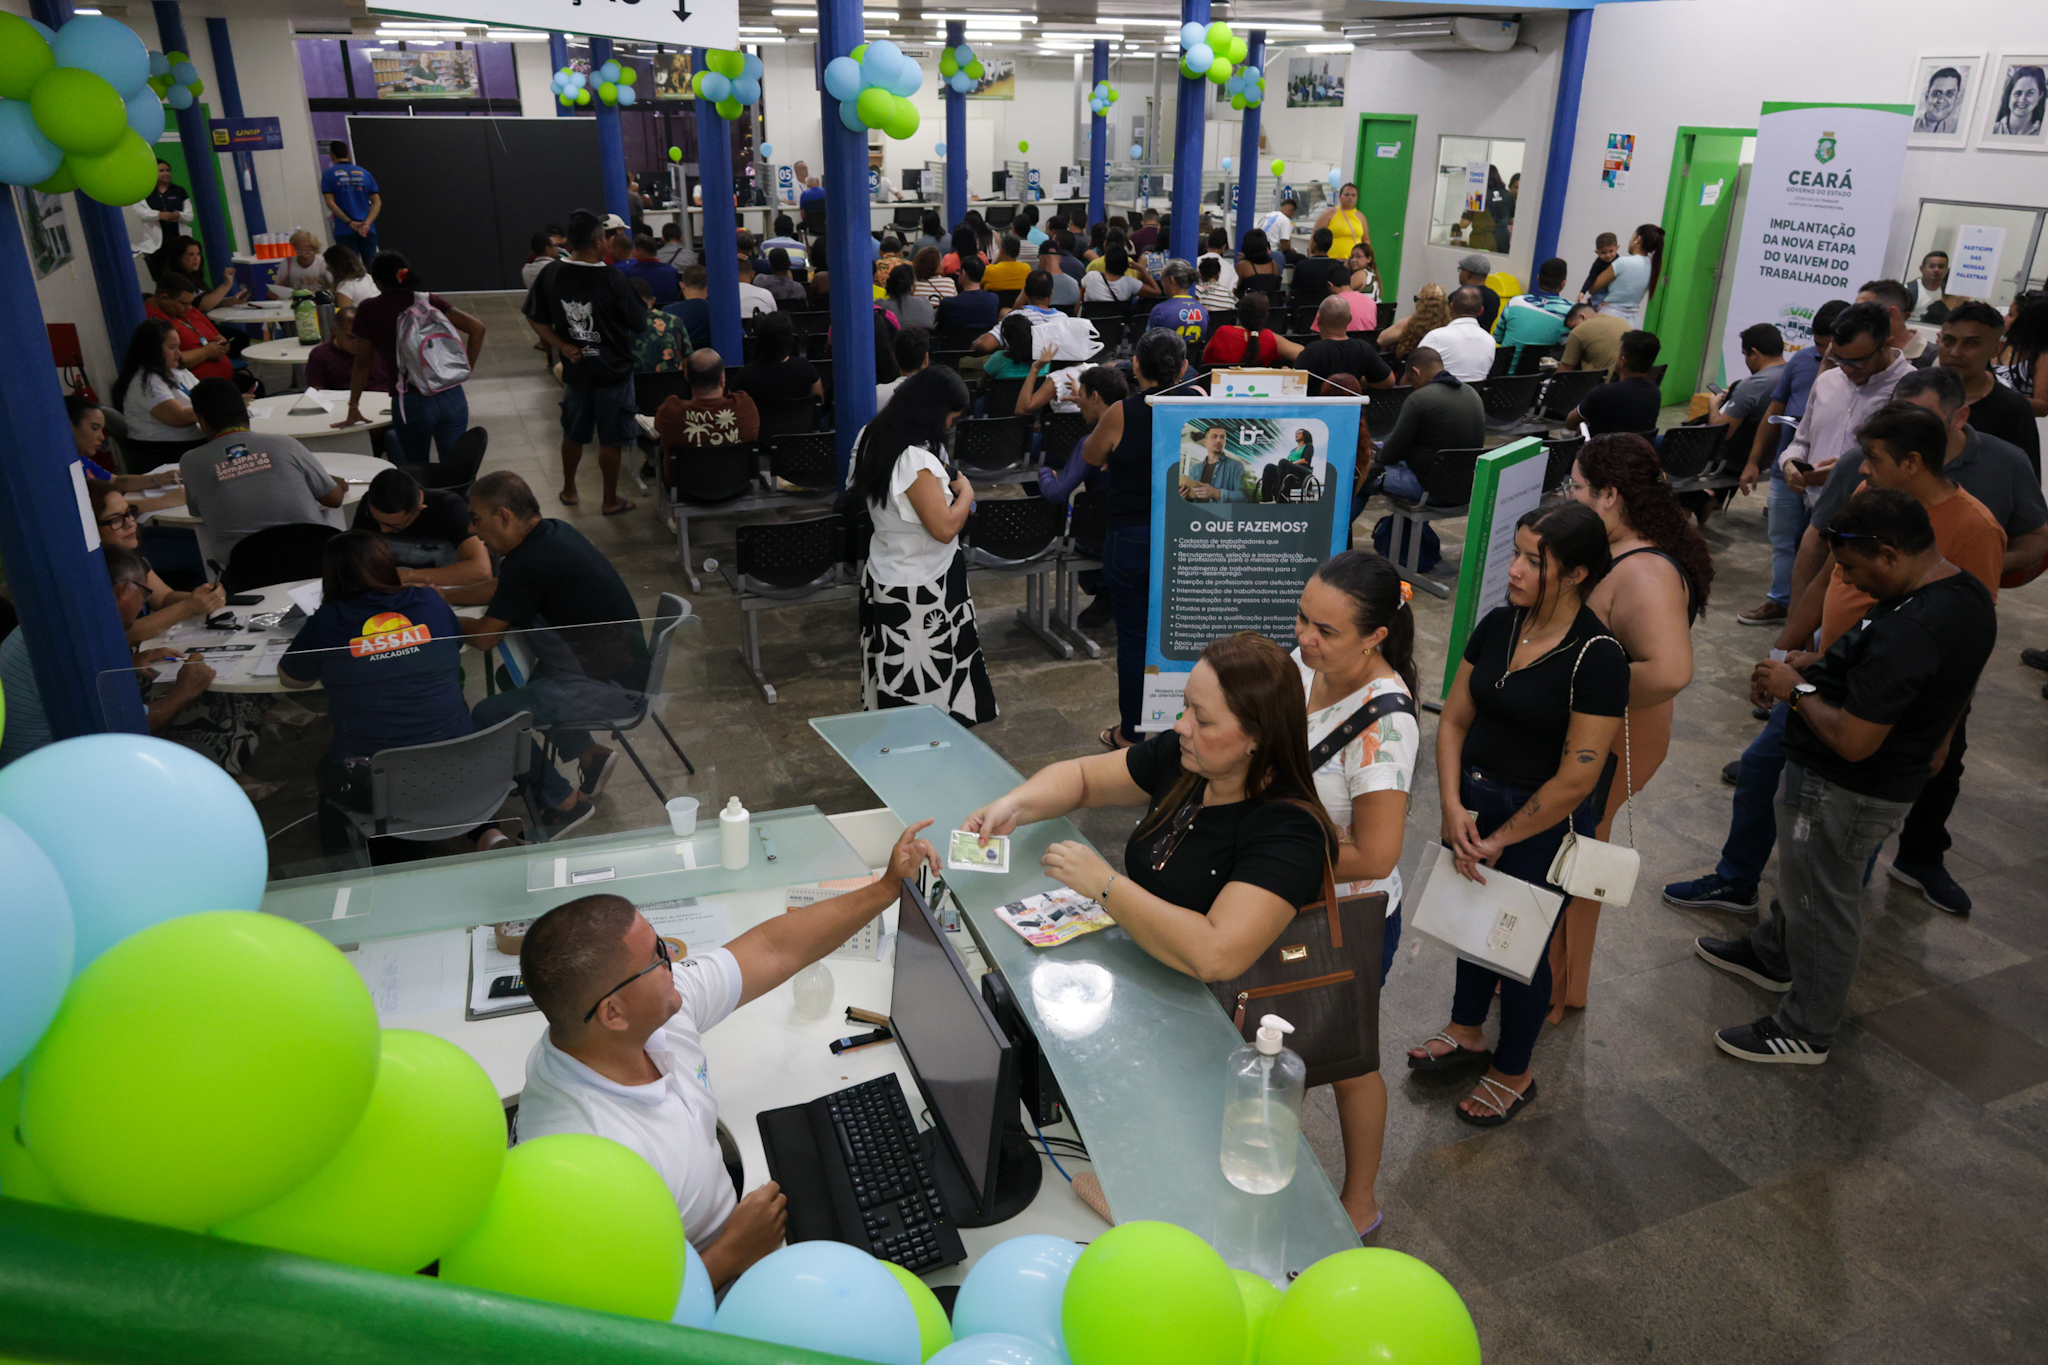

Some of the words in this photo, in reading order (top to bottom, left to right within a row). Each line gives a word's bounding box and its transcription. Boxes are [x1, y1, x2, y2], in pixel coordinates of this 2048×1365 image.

[236, 128, 260, 136] UNIP
[780, 169, 792, 180] 05
[1028, 173, 1040, 182] 08
[1788, 168, 1852, 190] CEARÁ
[1786, 186, 1816, 195] GOVERNO
[1827, 190, 1852, 198] ESTADO
[1770, 218, 1856, 239] IMPLANTAÇÃO
[1762, 234, 1778, 246] DA
[1782, 236, 1814, 250] NOVA
[1817, 240, 1856, 256] ETAPA
[1963, 244, 1994, 252] PARTICIPE
[1764, 250, 1781, 262] DO
[1784, 252, 1828, 268] VAIVEM
[1830, 260, 1849, 271] DO
[1760, 266, 1848, 288] TRABALHADOR
[1956, 272, 1988, 280] PALESTRAS
[1178, 308, 1202, 322] OAB
[1782, 342, 1801, 352] EM
[232, 452, 259, 466] SIPAT
[216, 461, 255, 477] Semana
[257, 458, 270, 466] do
[1486, 489, 1494, 522] Centro
[1190, 520, 1202, 532] O
[1205, 520, 1234, 533] QUE
[1238, 520, 1309, 533] FAZEMOS?
[1177, 578, 1204, 586] Inserção
[1223, 614, 1262, 622] qualificação
[360, 627, 423, 654] ASSAÍ
[1175, 631, 1205, 639] Execução
[370, 646, 420, 662] ATACADISTA
